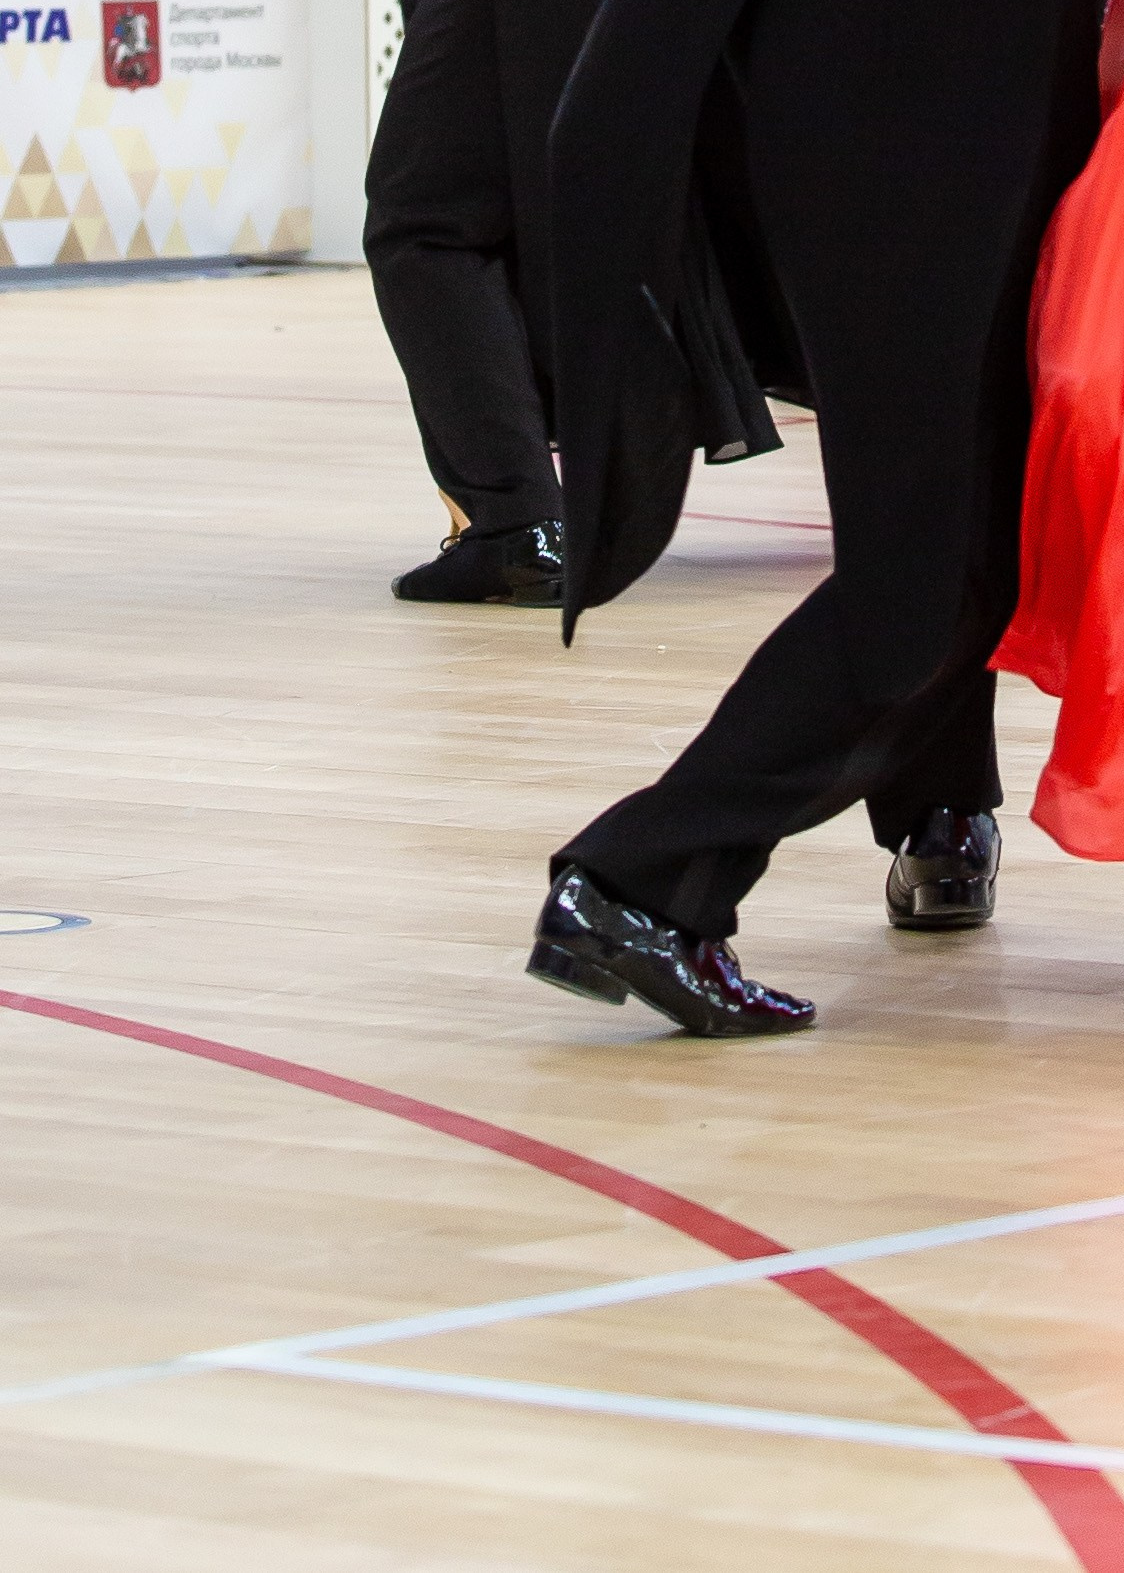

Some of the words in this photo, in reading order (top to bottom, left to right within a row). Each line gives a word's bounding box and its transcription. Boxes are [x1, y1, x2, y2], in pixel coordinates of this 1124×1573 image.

[169, 3, 264, 24] Департамент
[0, 8, 71, 44] РТА
[170, 31, 220, 48] спорта
[170, 56, 222, 74] города
[226, 52, 282, 69] Москвы
